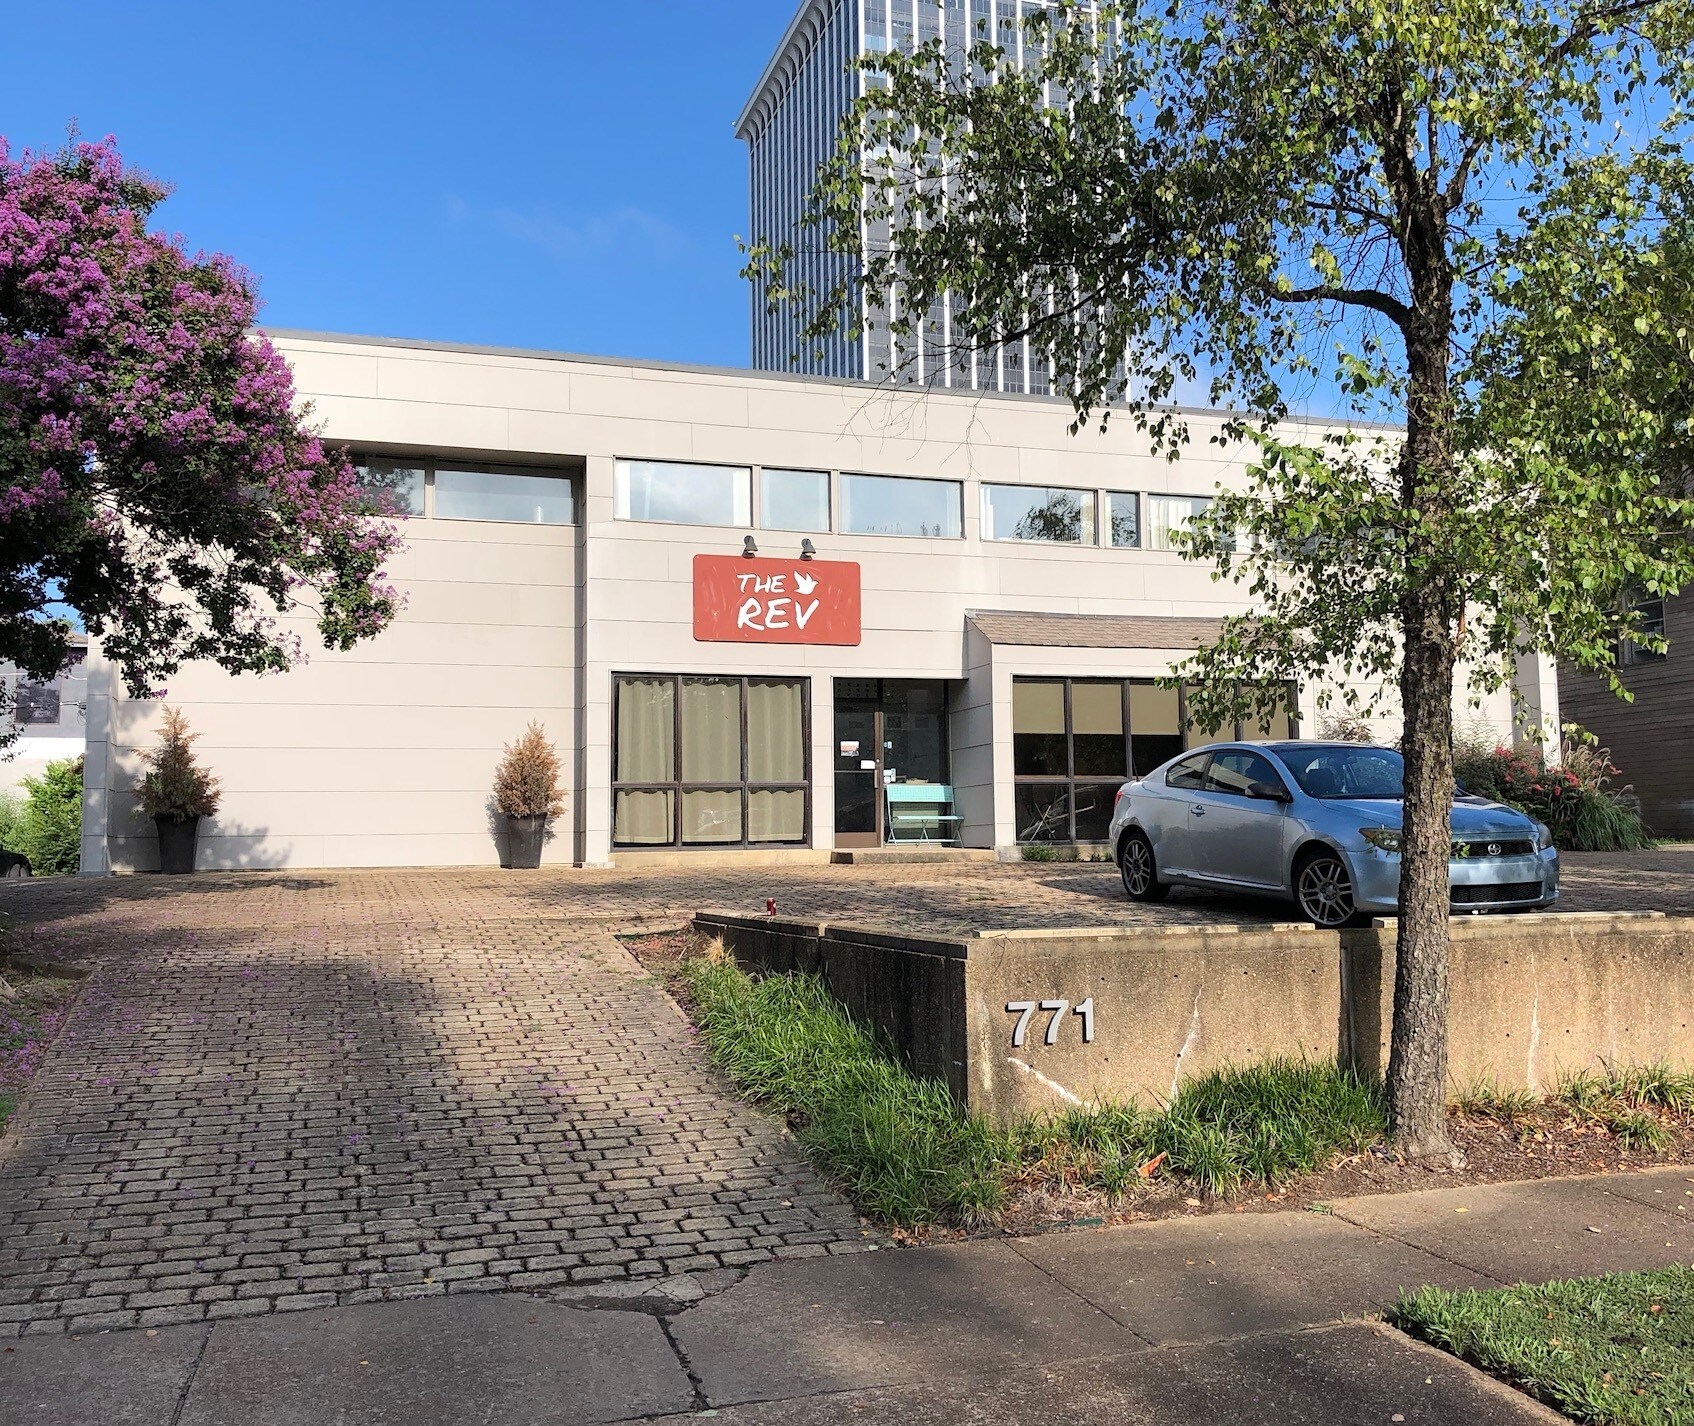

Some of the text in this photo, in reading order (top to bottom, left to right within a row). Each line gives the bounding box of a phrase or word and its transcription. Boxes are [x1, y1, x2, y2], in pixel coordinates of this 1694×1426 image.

[737, 574, 787, 593] THE
[737, 597, 820, 631] REV
[1006, 997, 1095, 1046] 771
